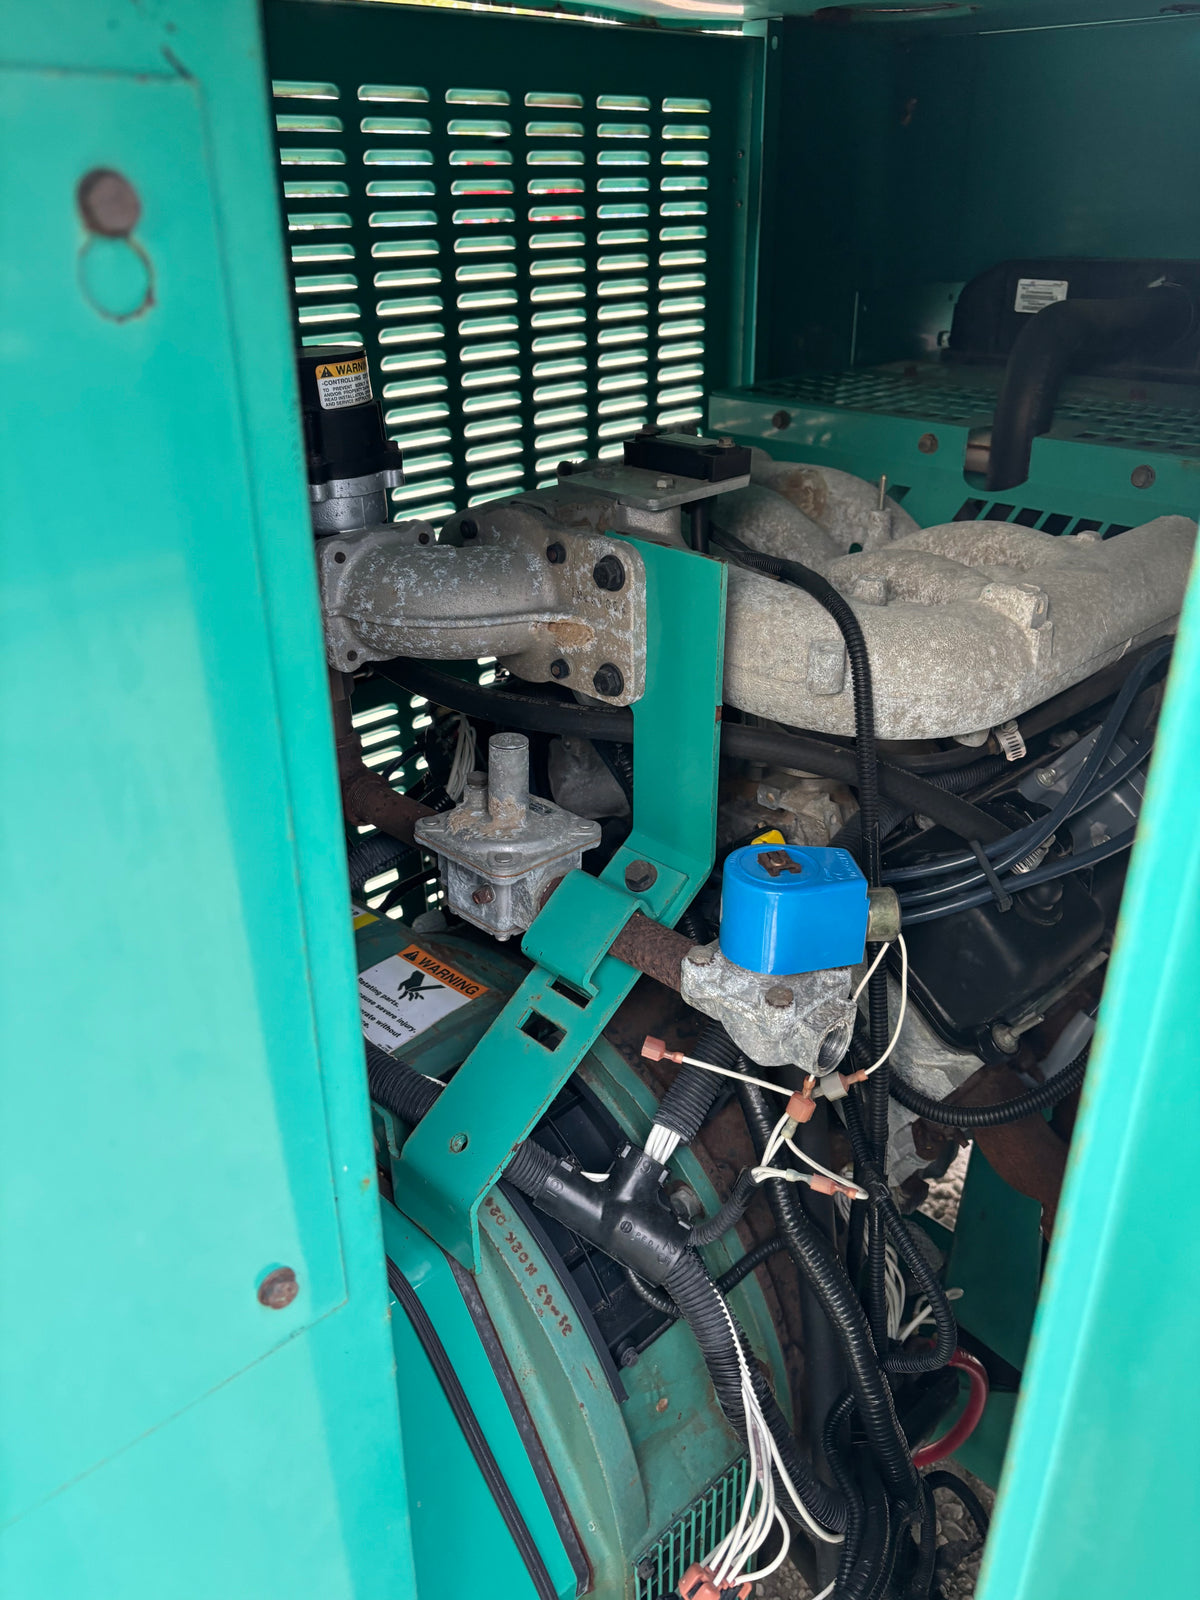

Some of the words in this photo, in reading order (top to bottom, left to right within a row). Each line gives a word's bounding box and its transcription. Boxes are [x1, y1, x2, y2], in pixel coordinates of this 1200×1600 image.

[418, 956, 479, 996] WARNING
[381, 993, 400, 1008] parts.
[375, 1003, 396, 1020] severe
[396, 1016, 417, 1034] injury.
[375, 1018, 402, 1038] without
